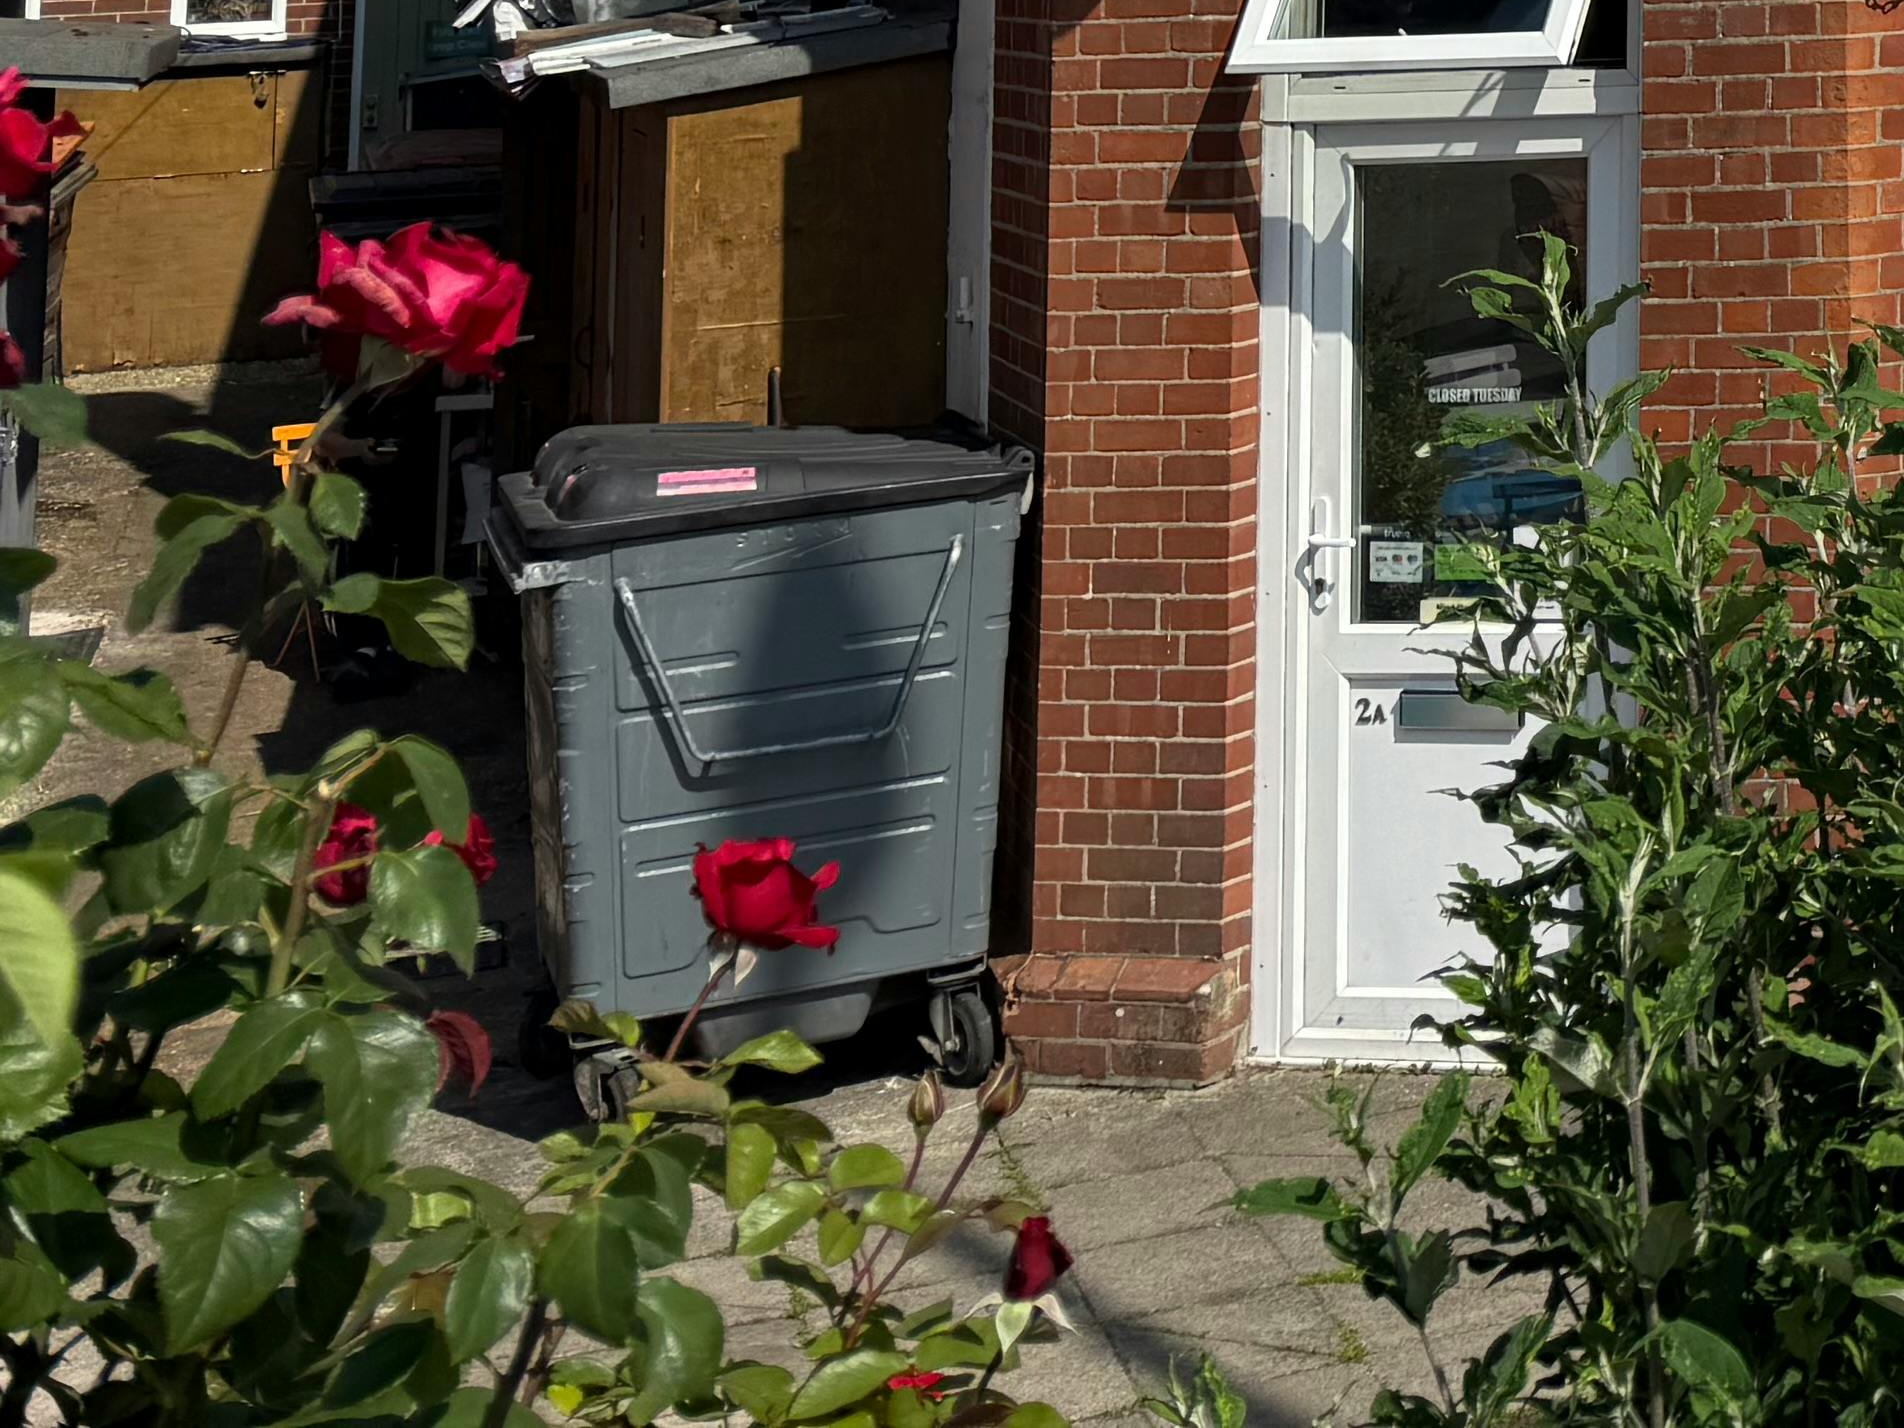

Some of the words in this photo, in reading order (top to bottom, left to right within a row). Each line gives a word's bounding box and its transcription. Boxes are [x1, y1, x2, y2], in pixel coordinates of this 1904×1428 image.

[1428, 388, 1470, 403] CLOSED
[1472, 386, 1522, 403] TUESDAY
[1355, 697, 1388, 726] 2A
